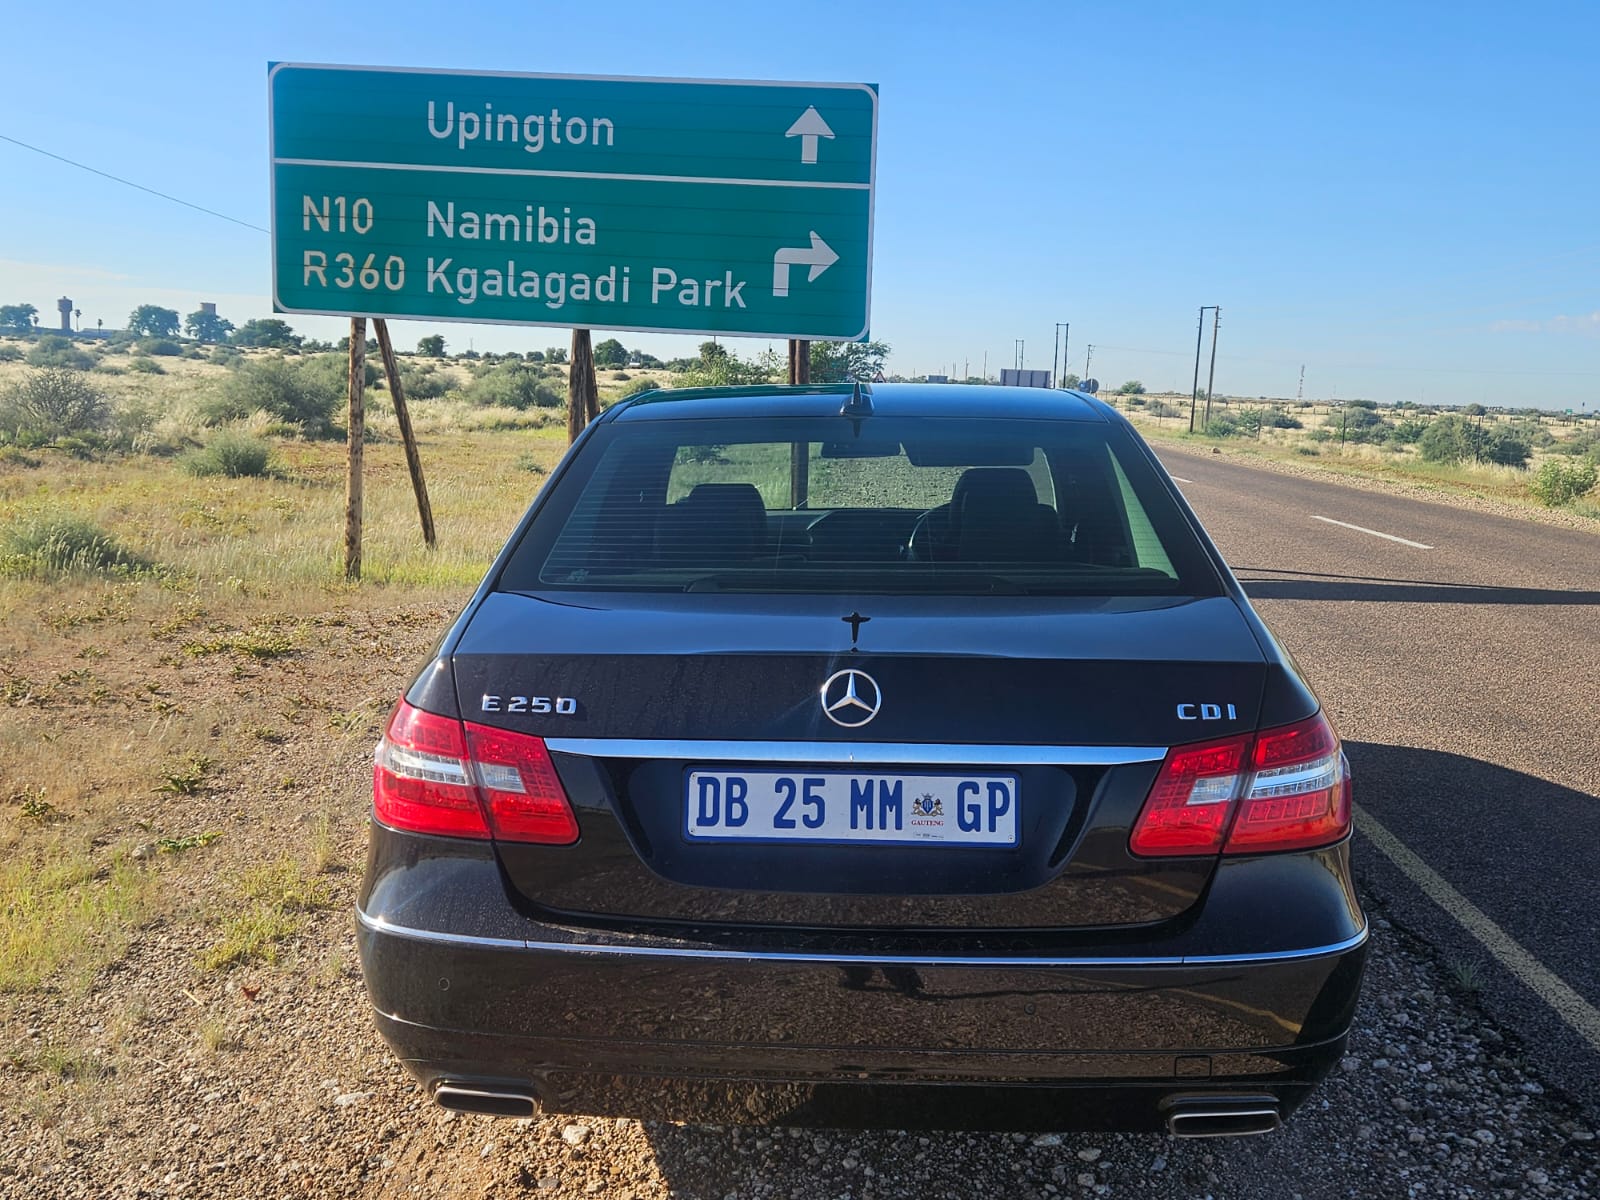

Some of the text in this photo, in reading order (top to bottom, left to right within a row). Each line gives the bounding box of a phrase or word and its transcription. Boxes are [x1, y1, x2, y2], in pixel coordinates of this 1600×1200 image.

[427, 101, 614, 153] Upington
[303, 195, 597, 246] N10 Namibia
[303, 251, 748, 309] R360 Kgalagadi Park
[1176, 703, 1237, 720] CDI
[696, 776, 1010, 833] DB 25 MM GP
